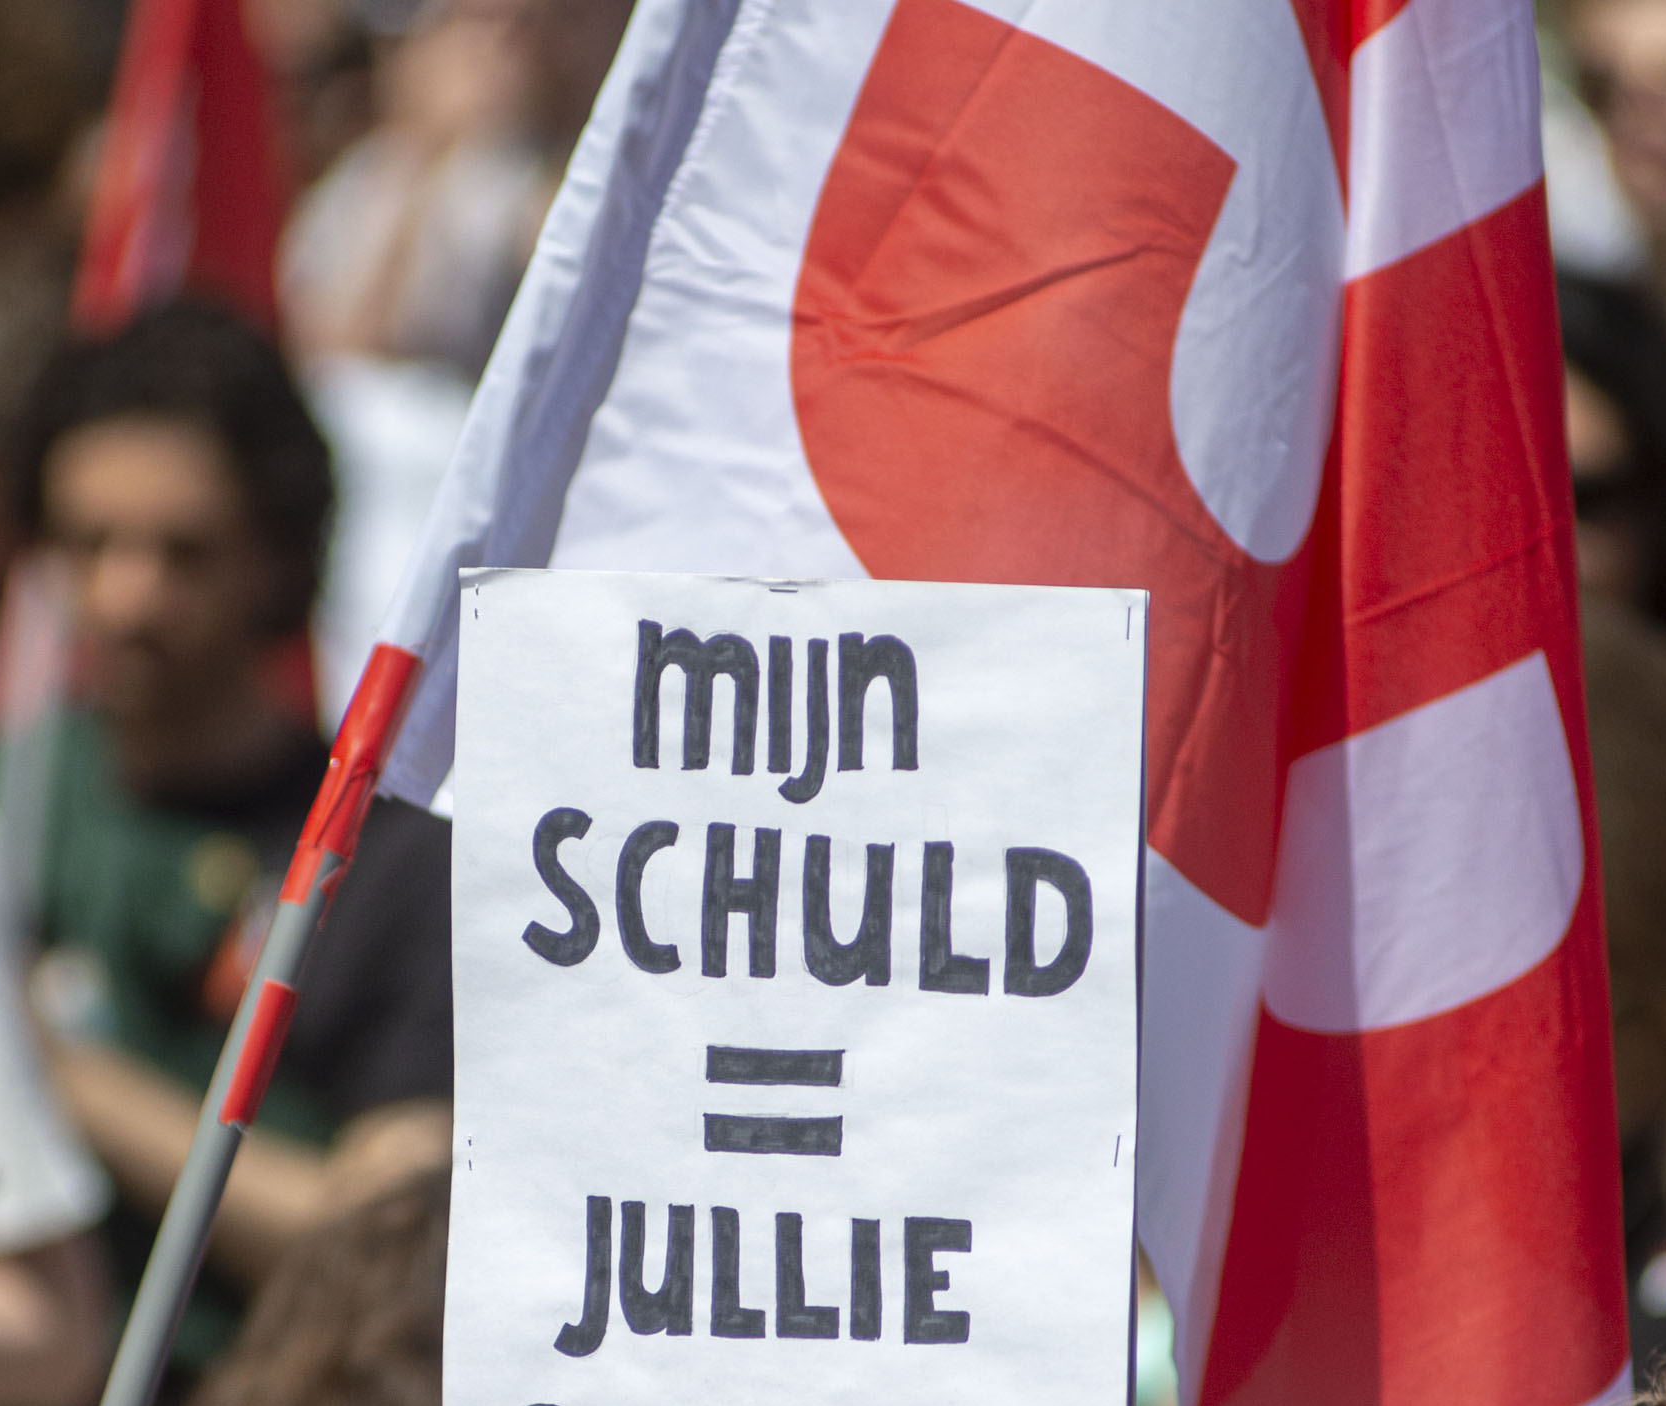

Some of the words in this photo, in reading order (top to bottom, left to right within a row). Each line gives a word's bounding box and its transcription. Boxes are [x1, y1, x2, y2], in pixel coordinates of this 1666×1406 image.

[521, 807, 1094, 998] SCHULD
[703, 1043, 845, 1156] =
[553, 1195, 973, 1358] JULLIE
